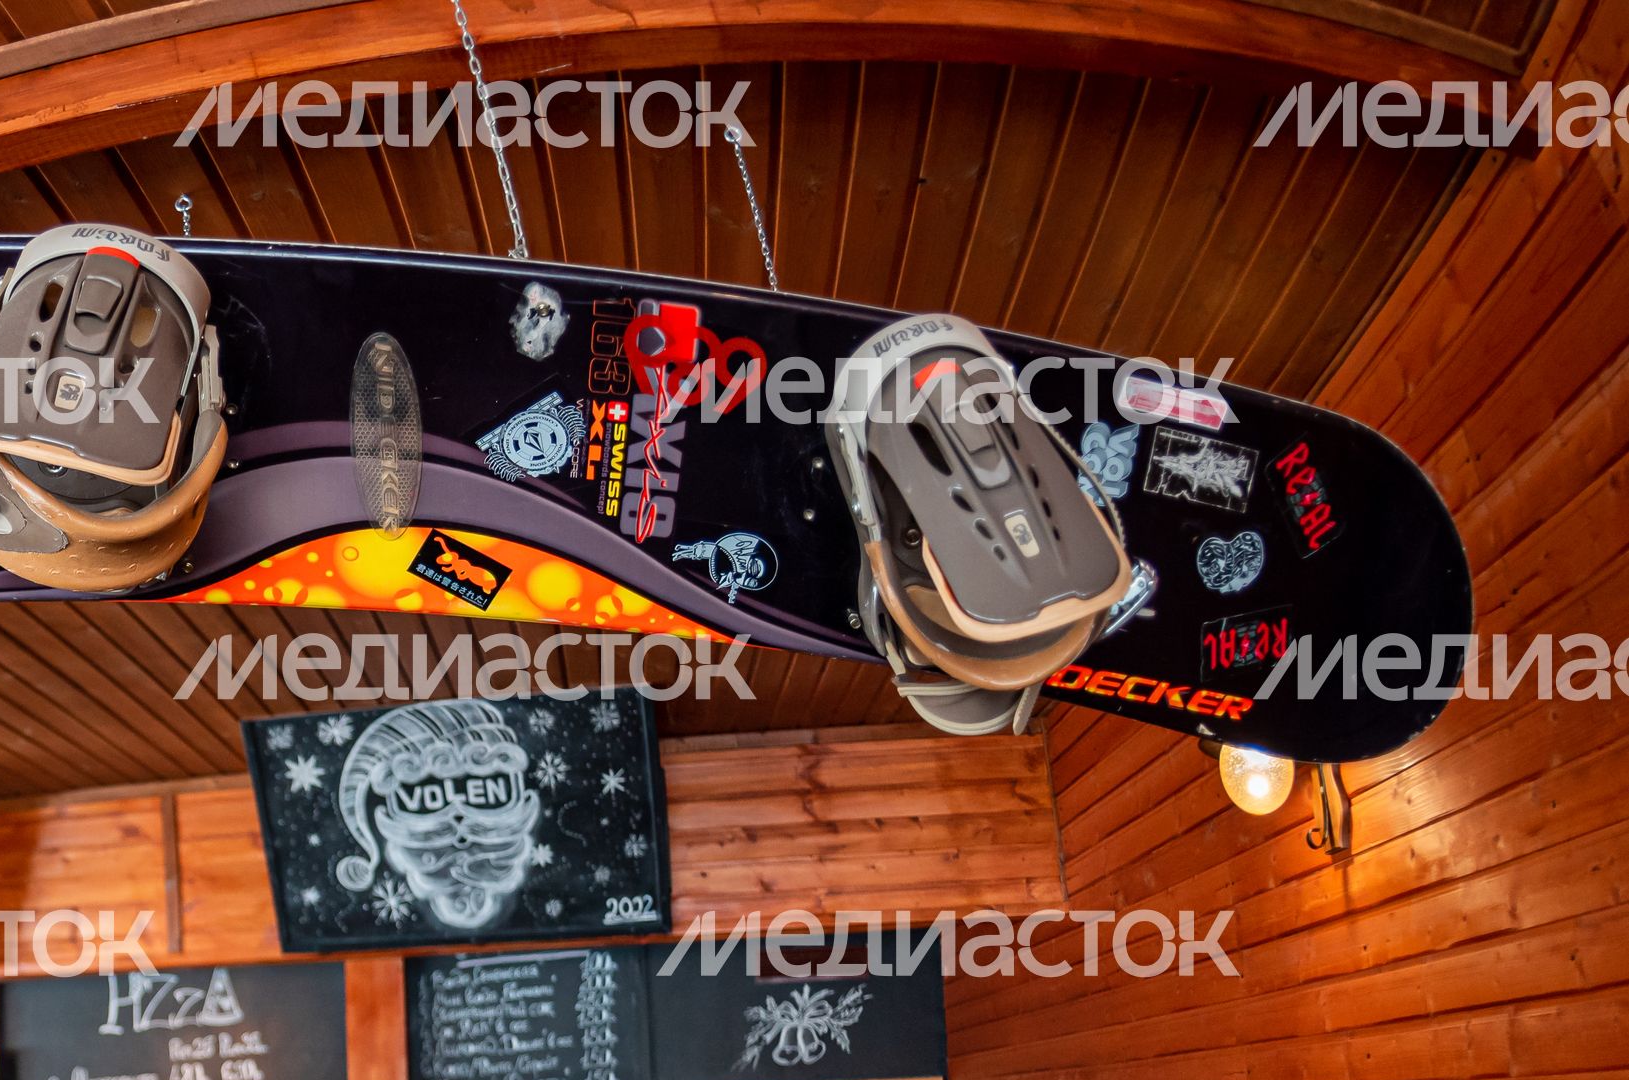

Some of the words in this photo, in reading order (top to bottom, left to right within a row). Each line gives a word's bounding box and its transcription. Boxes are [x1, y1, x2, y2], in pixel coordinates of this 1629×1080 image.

[588, 298, 634, 395] 163
[586, 399, 604, 480] XL
[607, 424, 625, 516] SWISS
[396, 776, 508, 812] VOLEN
[606, 894, 657, 918] 2022
